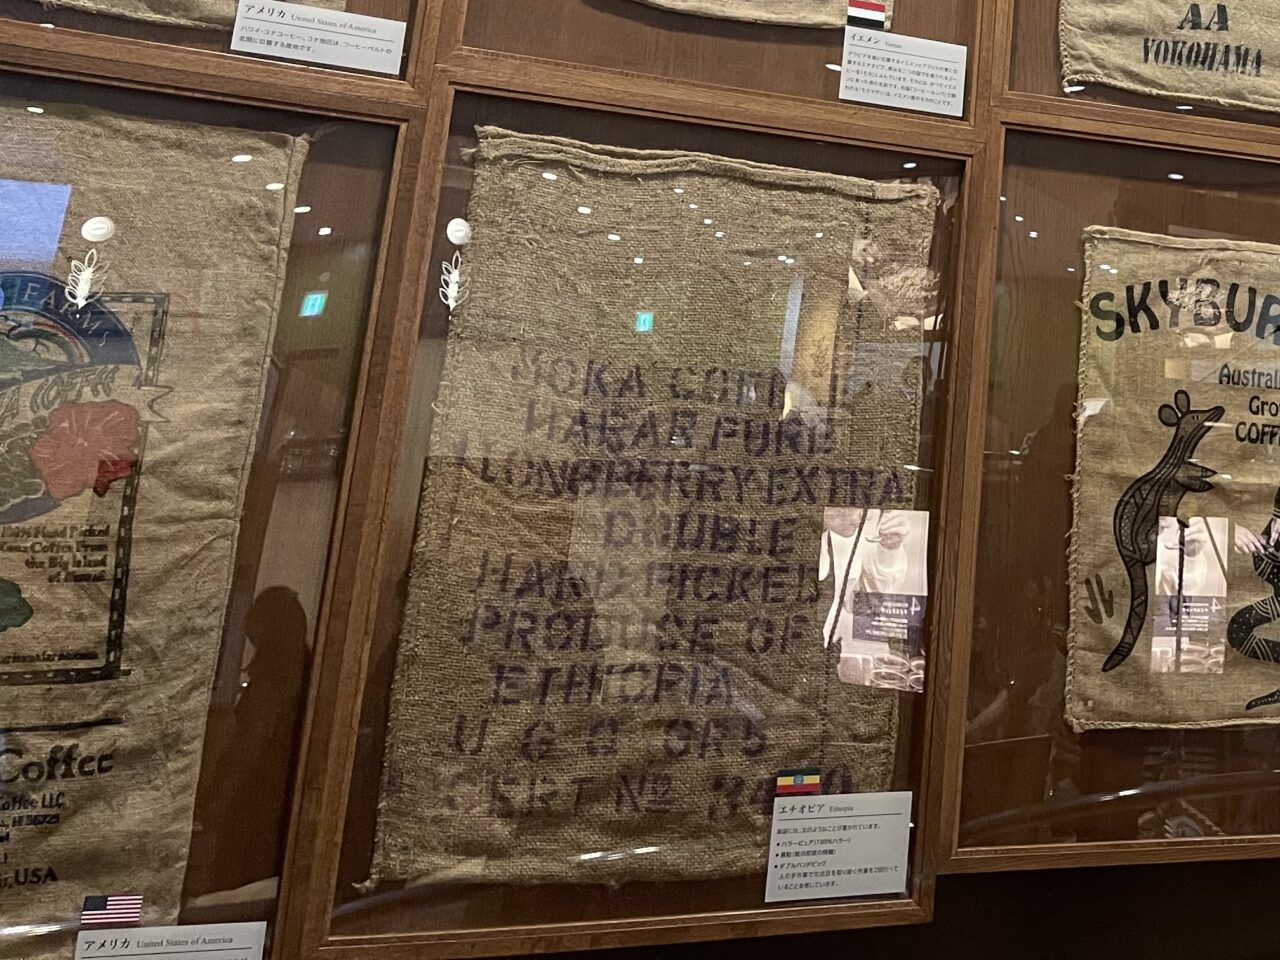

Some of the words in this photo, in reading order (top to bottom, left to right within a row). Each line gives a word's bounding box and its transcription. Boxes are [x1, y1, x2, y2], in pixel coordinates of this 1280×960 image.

[245, 4, 286, 19] アメリカ
[1177, 3, 1230, 31] AA
[850, 33, 880, 44] イエメン
[1142, 37, 1263, 77] YOKOHAMA
[779, 803, 825, 814] エチオピア
[14, 866, 59, 886] USA
[84, 938, 130, 951] アメリカ
[137, 939, 163, 948] United
[165, 939, 188, 947] States
[202, 936, 233, 945] America
